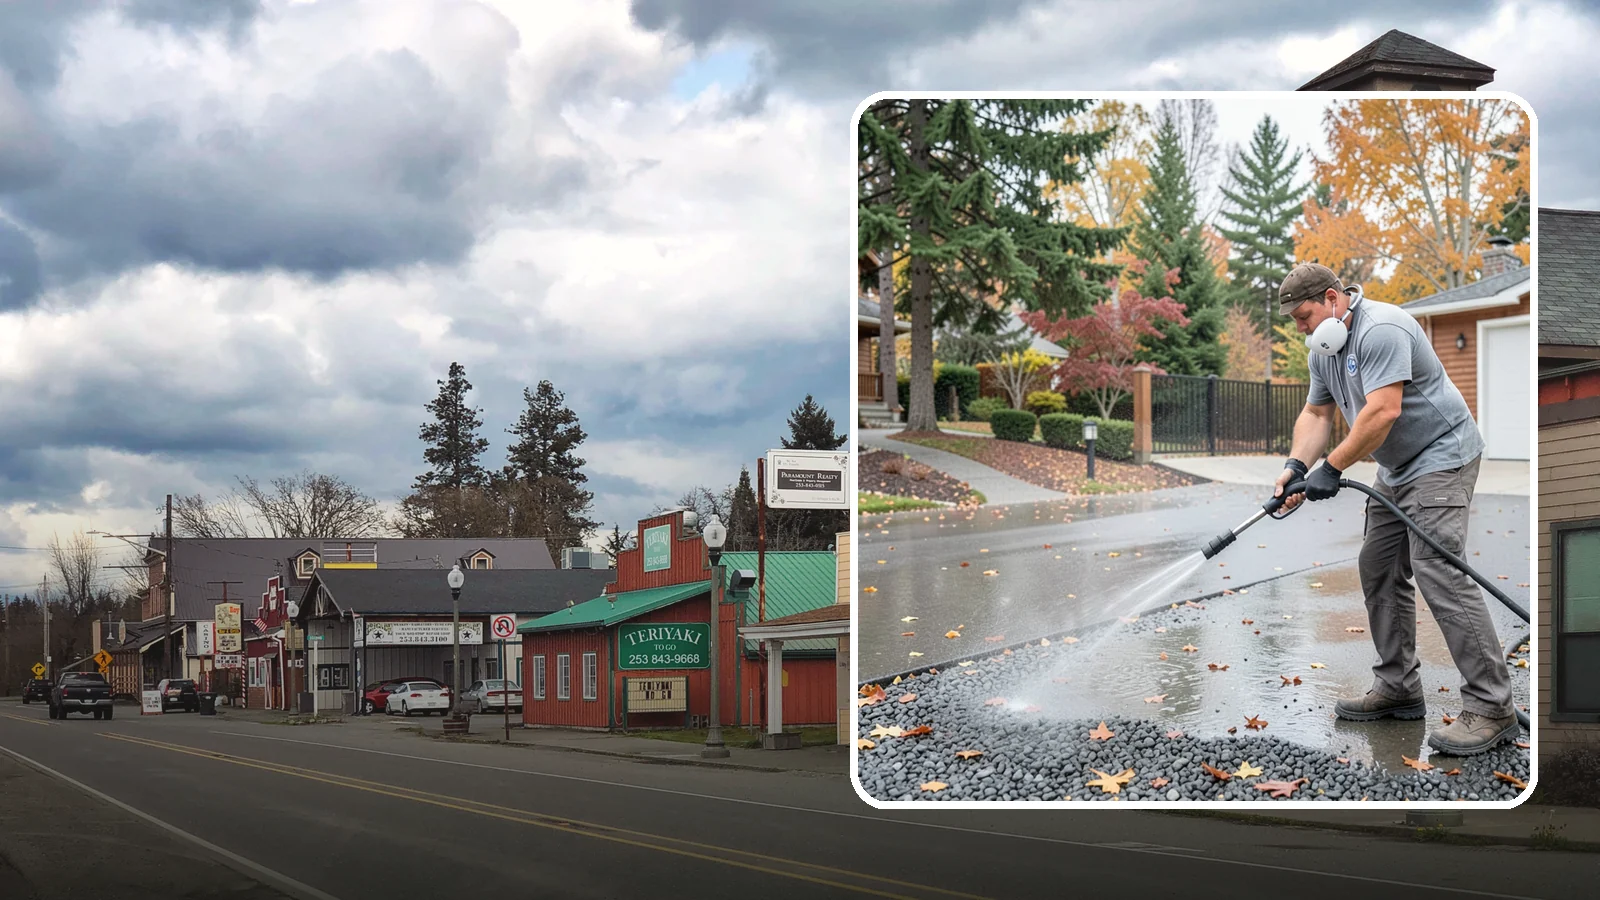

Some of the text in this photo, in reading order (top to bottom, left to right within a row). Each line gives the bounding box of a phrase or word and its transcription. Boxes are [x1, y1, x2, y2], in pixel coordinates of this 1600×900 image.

[781, 471, 839, 480] PARAMOUNT REALTY
[625, 627, 702, 646] TERIYAKI
[628, 653, 700, 665] 253 843-9668
